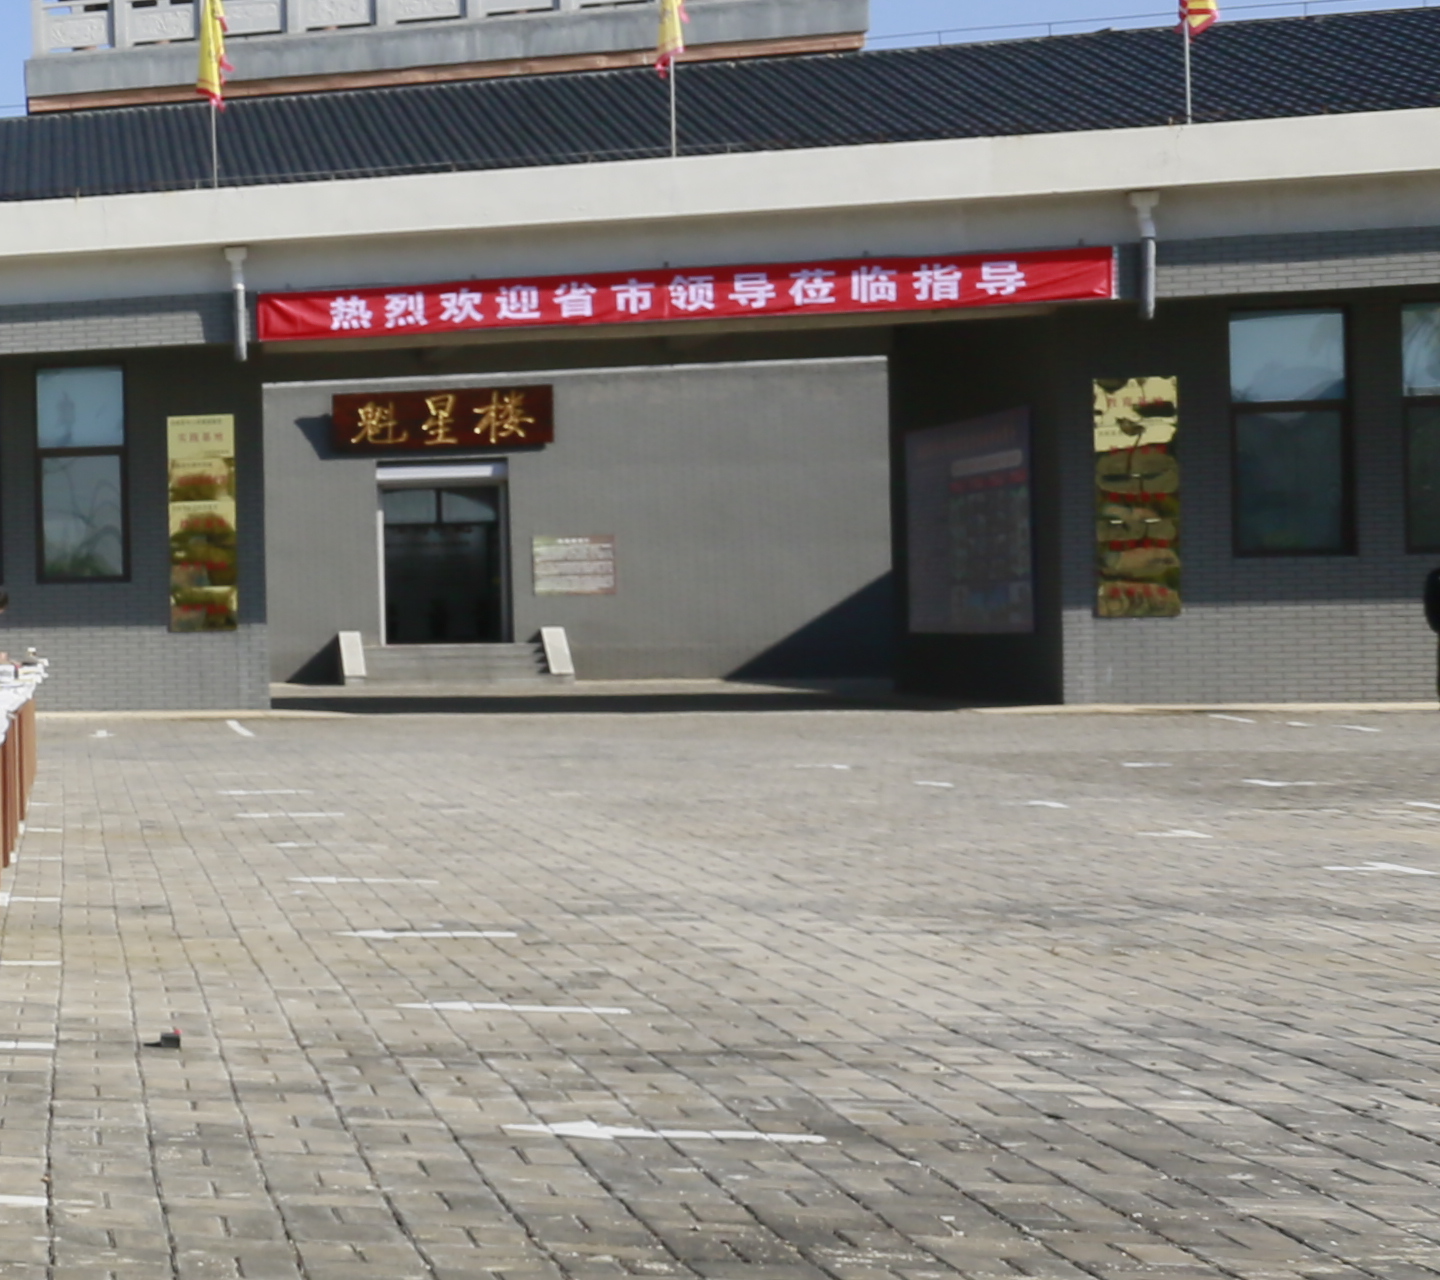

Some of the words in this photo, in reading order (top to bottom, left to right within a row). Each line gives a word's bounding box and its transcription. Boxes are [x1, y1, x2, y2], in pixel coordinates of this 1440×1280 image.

[329, 261, 1028, 330] 热烈欢迎省市领导莅临指导
[350, 389, 535, 445] 魁星楼
